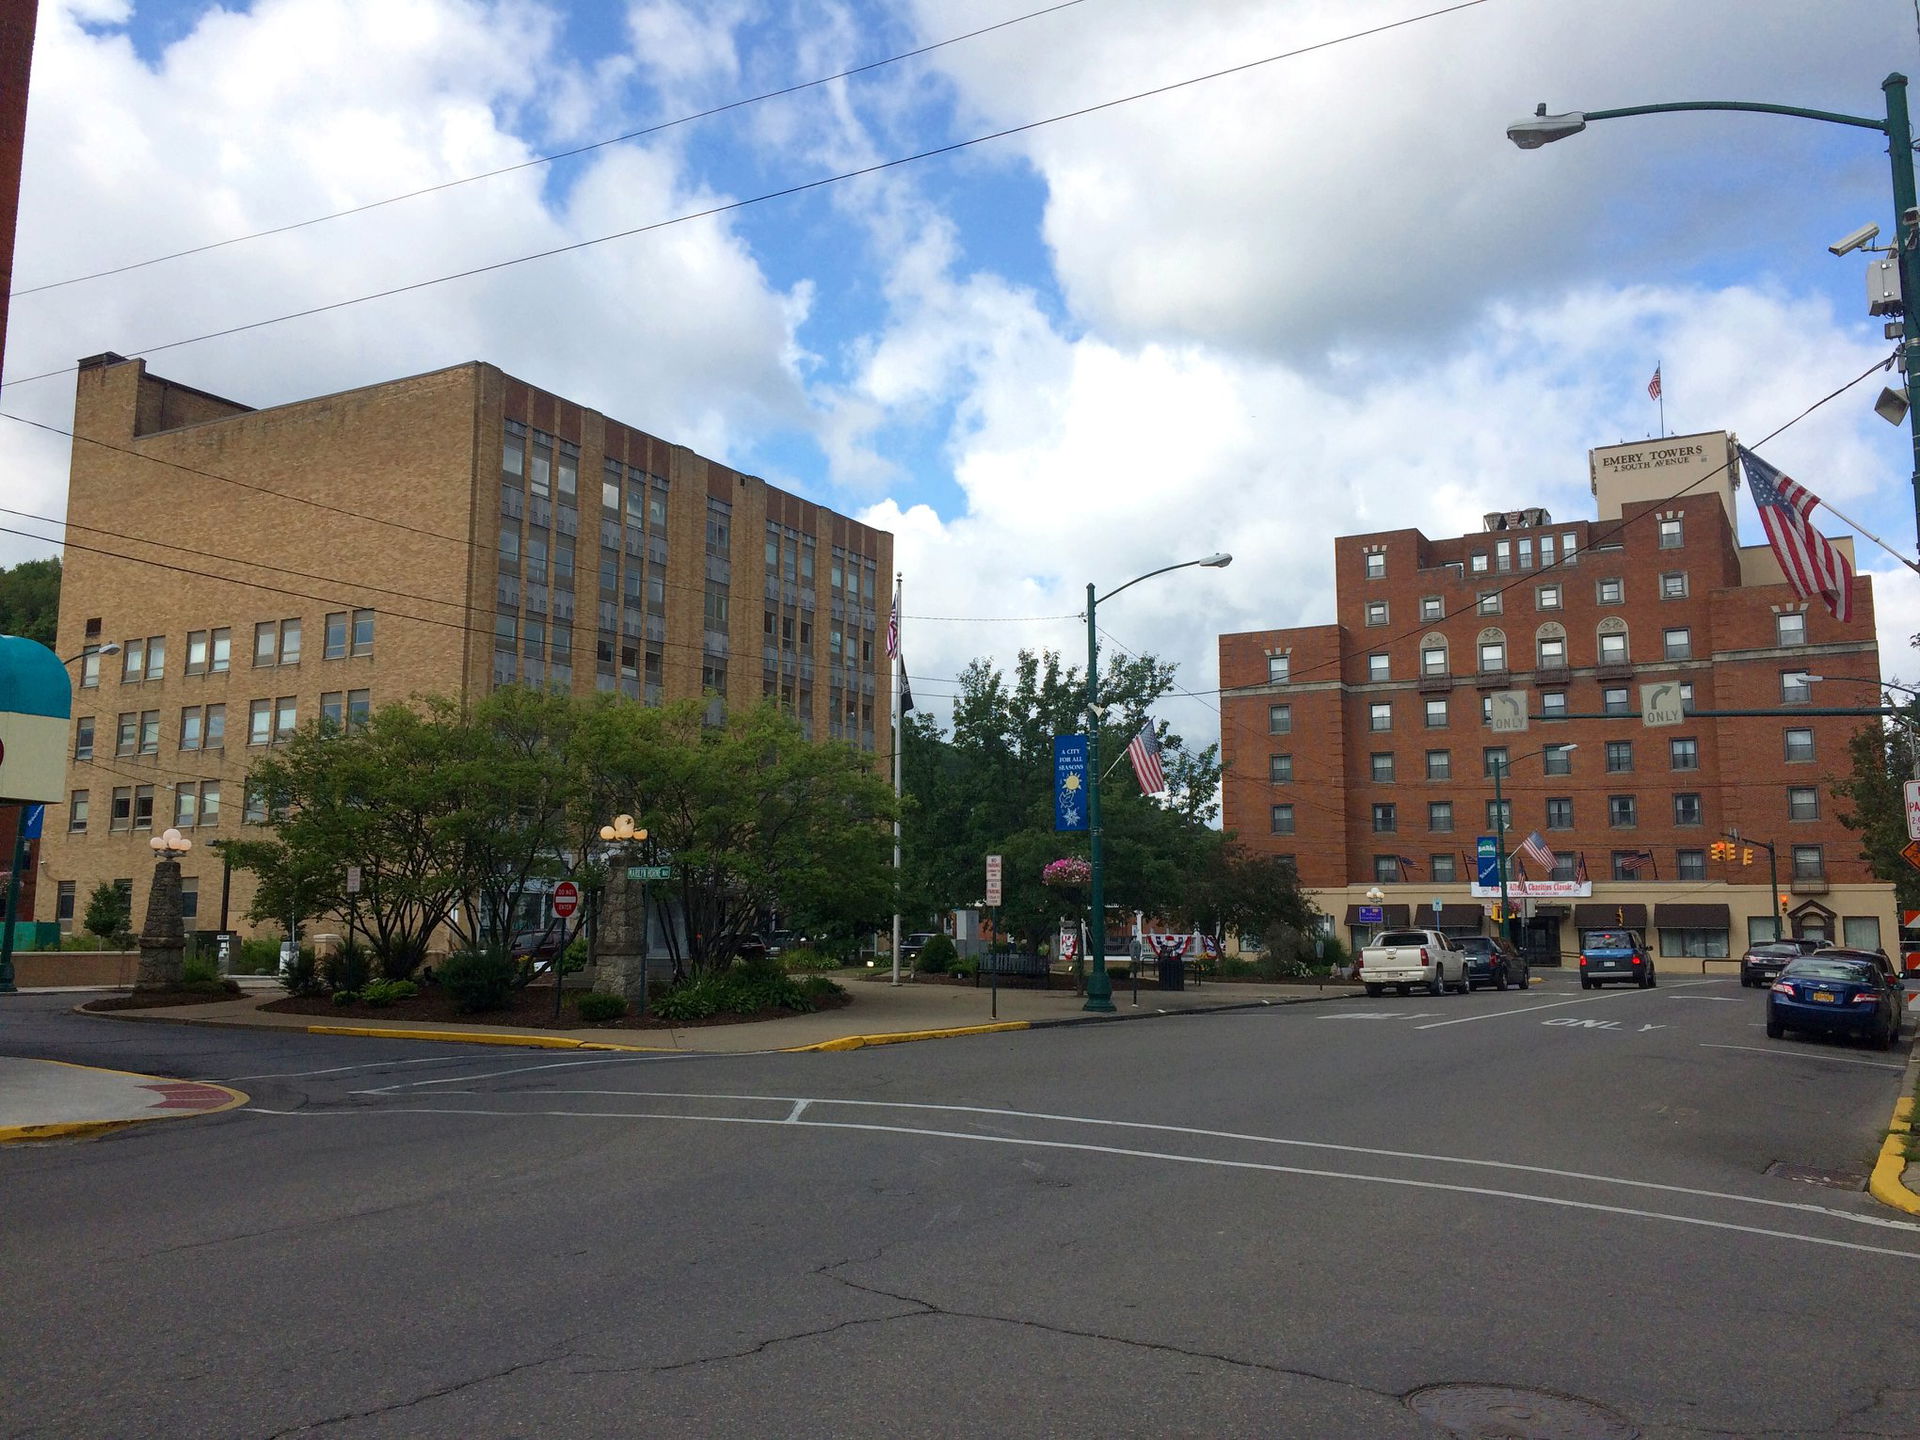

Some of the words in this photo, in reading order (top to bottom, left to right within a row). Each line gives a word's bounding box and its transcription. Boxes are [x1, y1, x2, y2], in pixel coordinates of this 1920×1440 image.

[1603, 453, 1643, 466] EMERY
[1649, 445, 1703, 460] TOWERS
[1621, 462, 1650, 472] SOUTH
[1654, 457, 1689, 467] AVENUE
[1496, 716, 1525, 729] ONLY
[1647, 709, 1679, 723] ONLY
